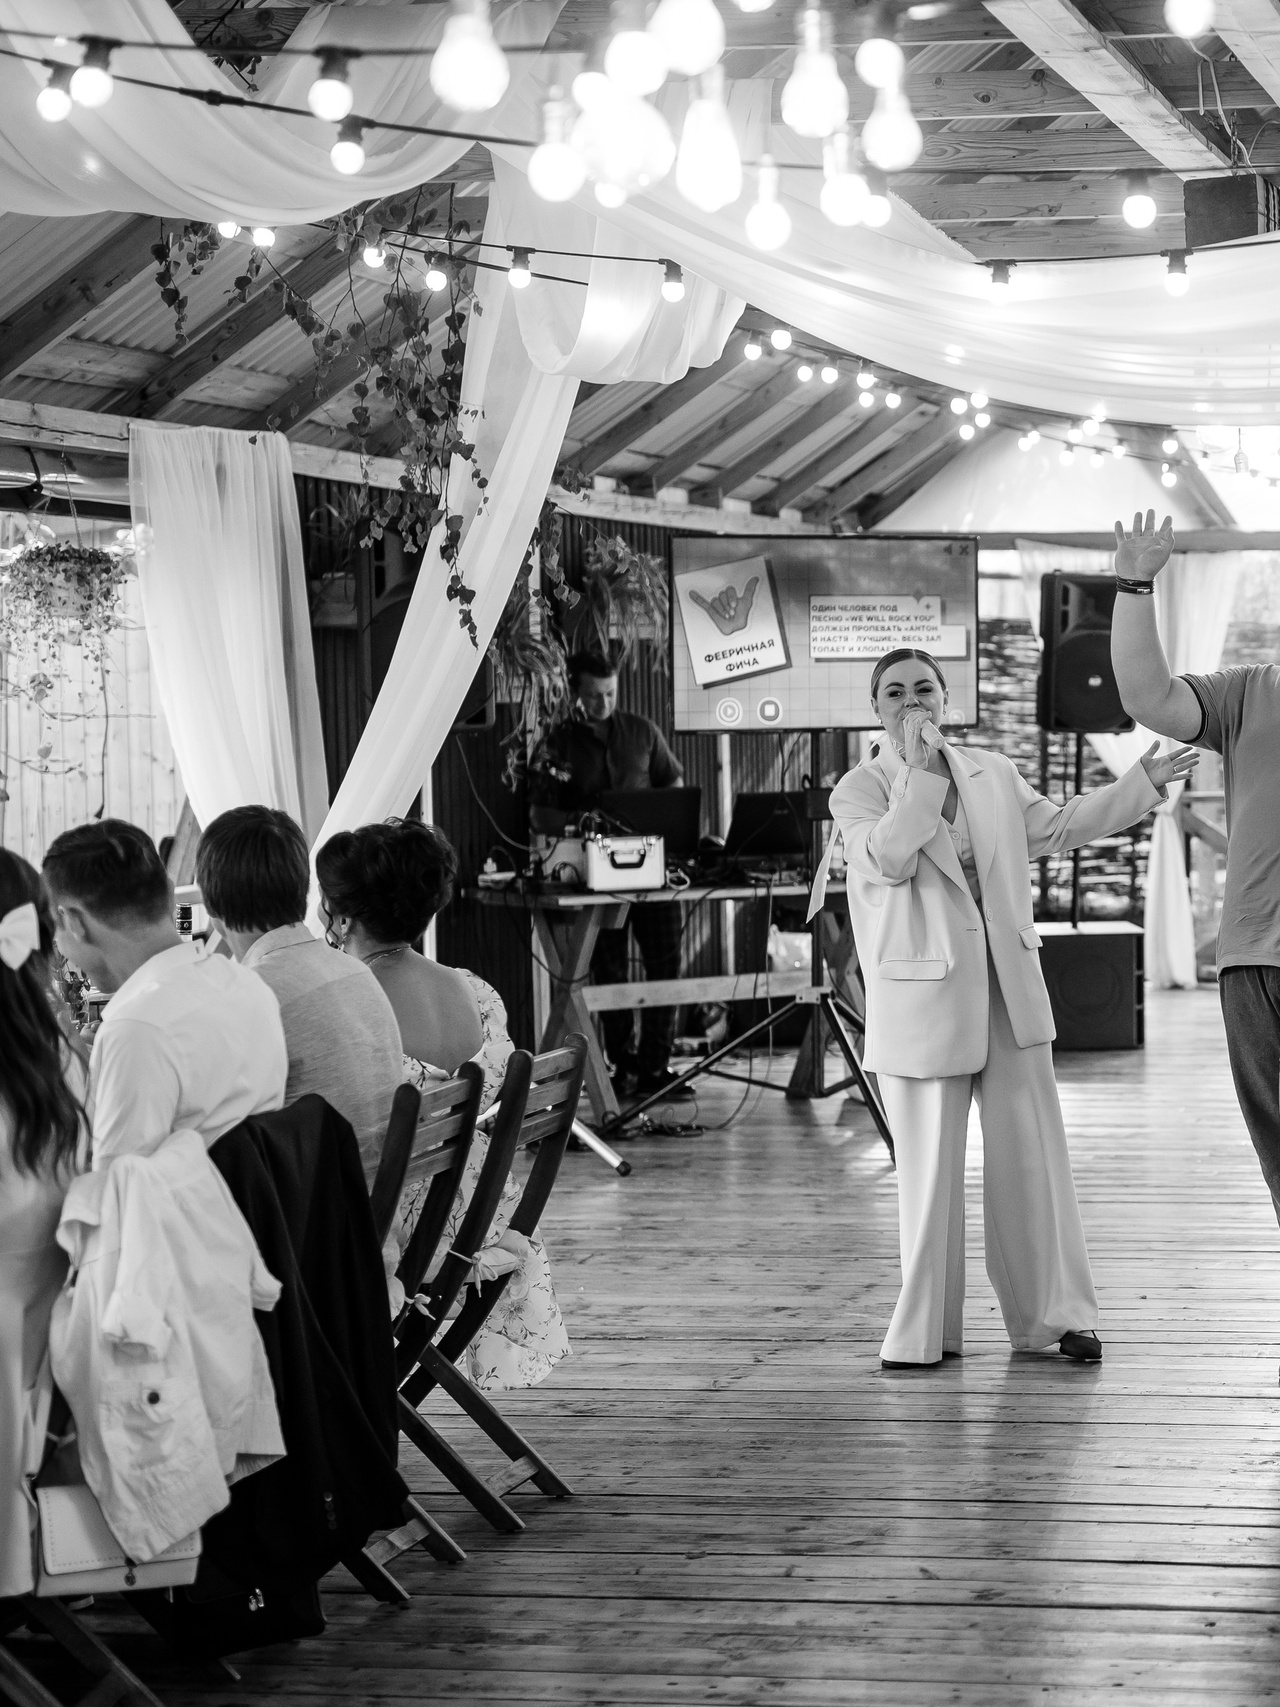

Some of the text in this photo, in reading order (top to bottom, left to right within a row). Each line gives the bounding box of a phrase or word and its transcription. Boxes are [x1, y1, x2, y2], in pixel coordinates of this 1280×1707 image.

[811, 604, 898, 612] ОДИН ЧЕЛОВЕК ПОД
[704, 639, 775, 663] ФЕЕРИЧНАЯ
[725, 657, 760, 672] ФИЧА
